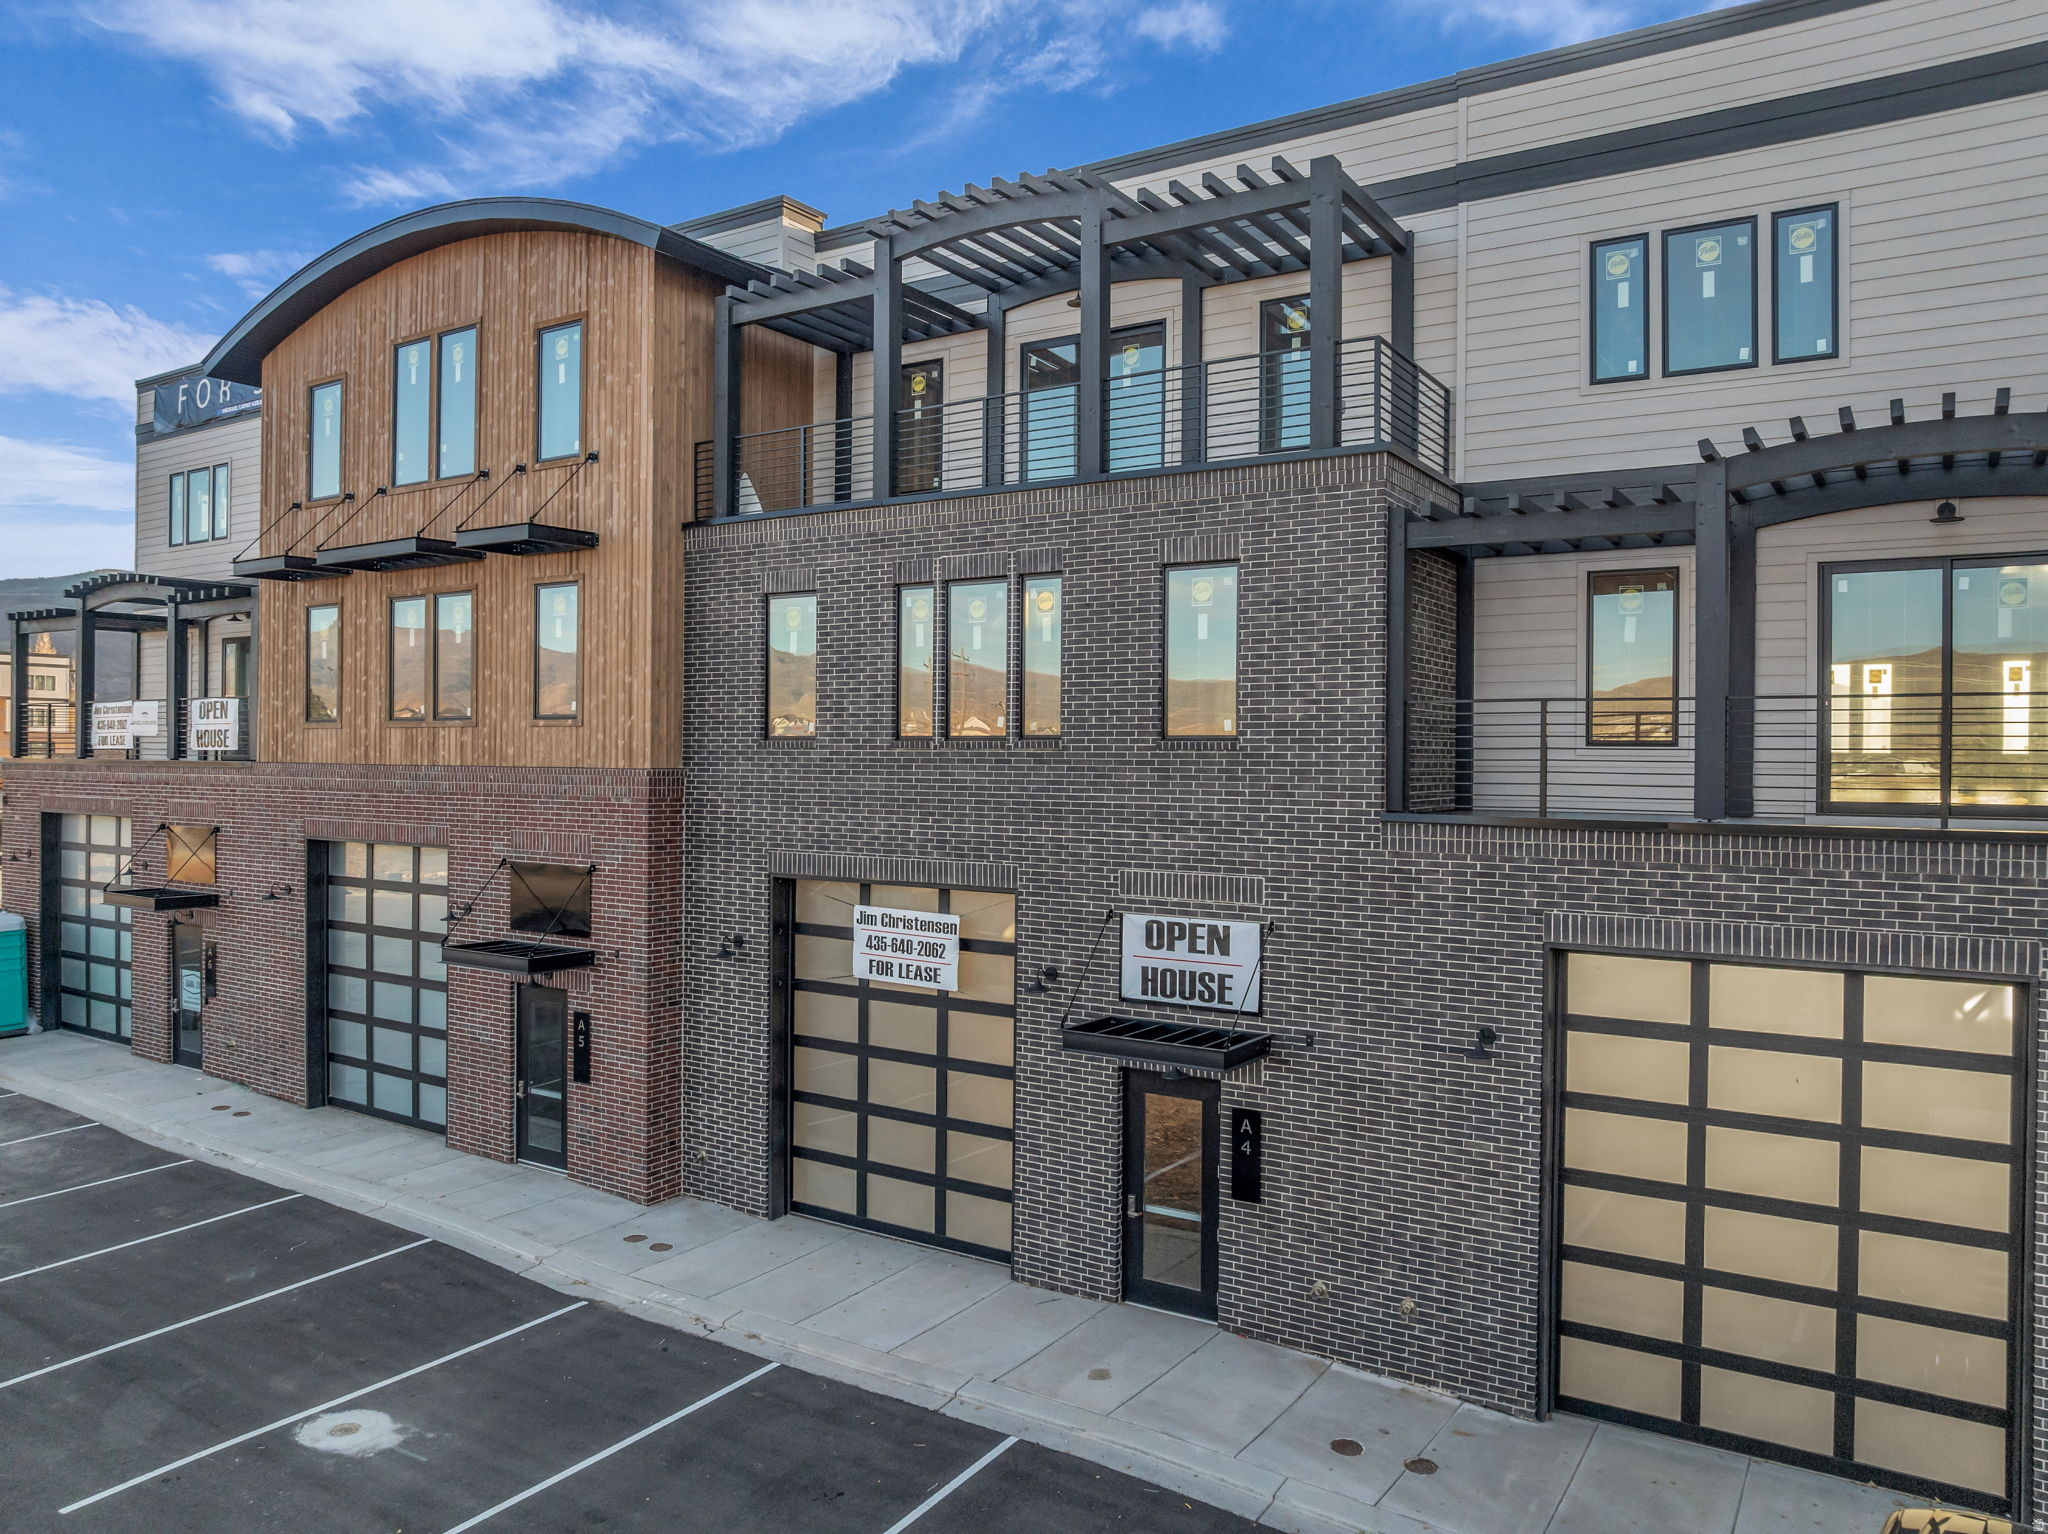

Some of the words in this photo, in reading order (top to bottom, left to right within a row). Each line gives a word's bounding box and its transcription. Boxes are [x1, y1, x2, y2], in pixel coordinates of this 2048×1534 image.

[178, 379, 231, 414] FOR
[199, 701, 228, 720] OPEN
[98, 735, 109, 746] FOR
[110, 735, 126, 746] LEASE
[197, 729, 229, 748] HOUSE
[856, 910, 877, 927] Jim
[881, 913, 958, 936] Christensen
[865, 934, 946, 960] 435-640-2062
[1145, 919, 1231, 957] OPEN
[868, 959, 894, 978] FOR
[898, 963, 941, 984] LEASE
[1141, 965, 1234, 1006] HOUSE
